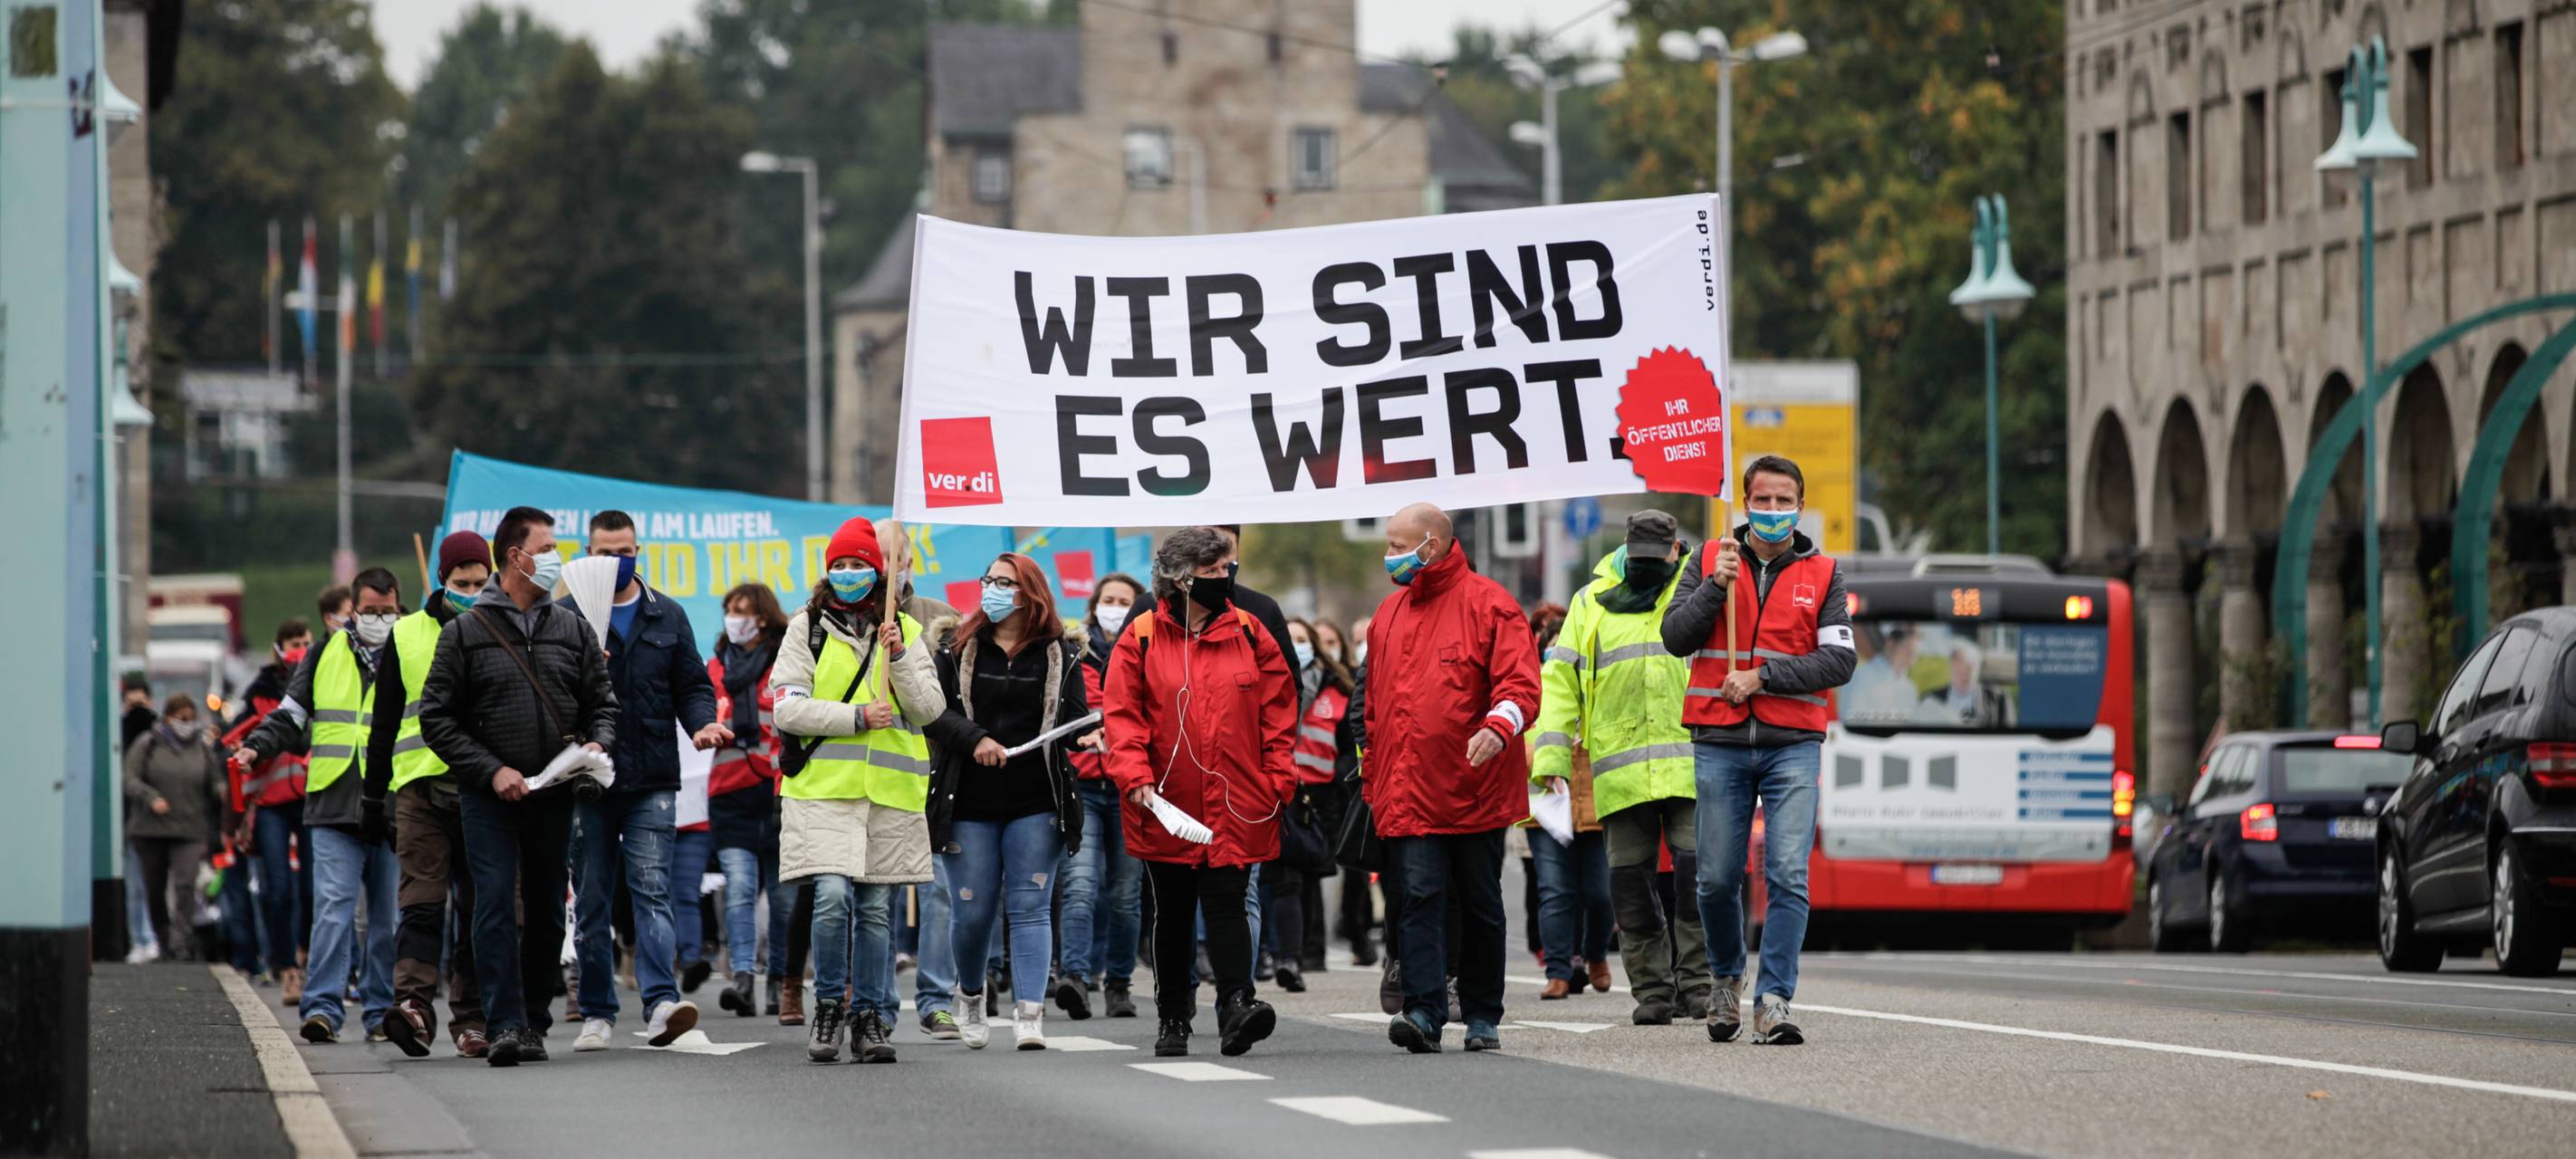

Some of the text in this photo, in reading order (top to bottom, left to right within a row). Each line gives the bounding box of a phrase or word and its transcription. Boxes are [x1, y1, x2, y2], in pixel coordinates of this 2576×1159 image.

[1696, 209, 1715, 311] verdi.de
[1014, 240, 1623, 378] WIR SIND
[1664, 398, 1689, 417] IHR
[1055, 358, 1633, 497] ES WERT.
[1627, 416, 1722, 445] ÖFFENTLICHER
[1663, 441, 1707, 463] DIENST
[928, 471, 995, 493] ver.di
[545, 508, 580, 537] EN
[650, 512, 685, 539] AM
[687, 510, 781, 540] LAUFEN.
[707, 538, 796, 598] IHR
